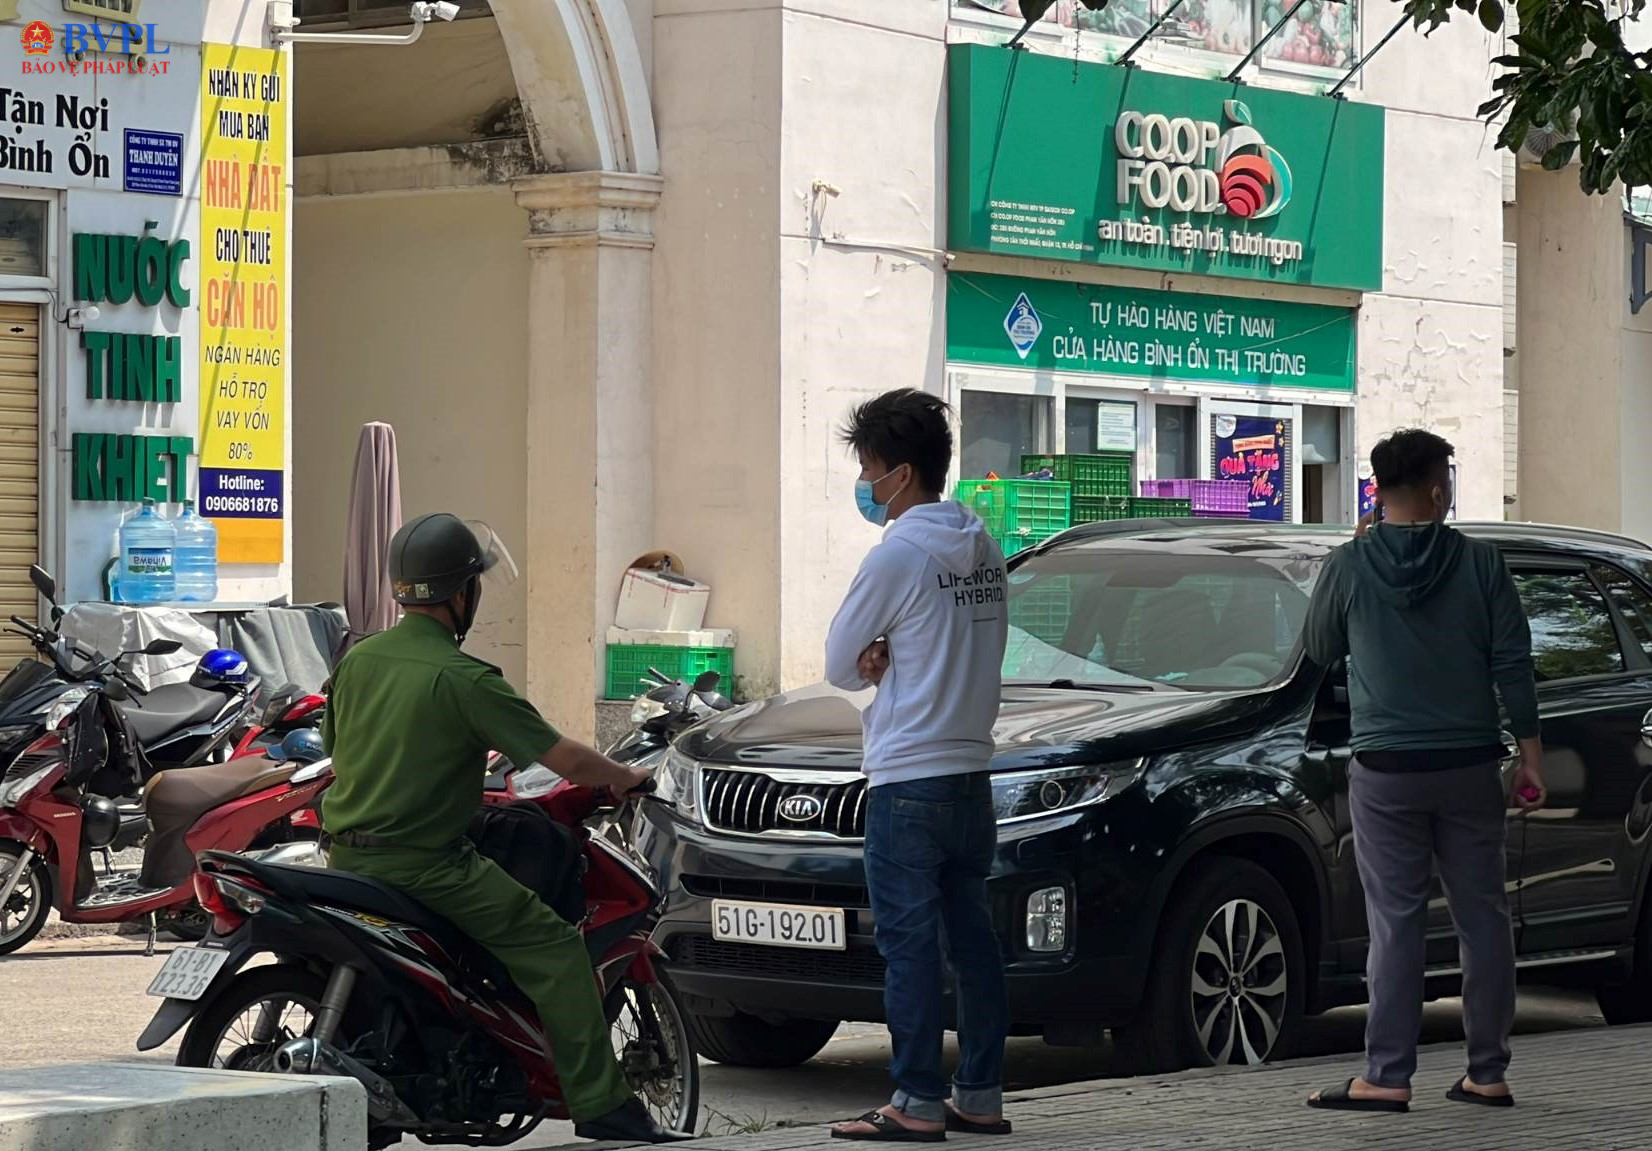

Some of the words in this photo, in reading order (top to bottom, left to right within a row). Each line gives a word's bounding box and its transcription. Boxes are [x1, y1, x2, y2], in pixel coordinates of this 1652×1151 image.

[56, 94, 108, 131] Nơi
[219, 110, 243, 139] MUA
[68, 132, 109, 178] Ổn
[216, 227, 239, 262] CHO
[243, 226, 271, 265] THUÊ
[207, 272, 245, 329] CĂN
[1090, 302, 1111, 328] TỰ
[1118, 303, 1149, 328] HÀO
[1155, 305, 1197, 332] HÀNG
[1204, 309, 1235, 337] VIỆT
[1241, 316, 1275, 338] NAM
[205, 341, 241, 364] NGÂN
[245, 343, 280, 366] HÀNG
[1053, 326, 1087, 360] CỬA
[1093, 336, 1139, 363] HÀNG
[1145, 338, 1182, 367] BÌNH
[1188, 337, 1209, 369] ỔN
[1216, 349, 1239, 375] THỊ
[1244, 348, 1306, 376] TRƯỜNG
[217, 410, 240, 428] VAY
[228, 442, 253, 460] 80%
[219, 474, 265, 491] Hotline:
[205, 496, 279, 513] 0906681876
[937, 567, 1004, 589] LIFEWOR
[954, 587, 1004, 607] HYBRID
[784, 799, 812, 816] KIA
[718, 906, 836, 944] 51G-192.01
